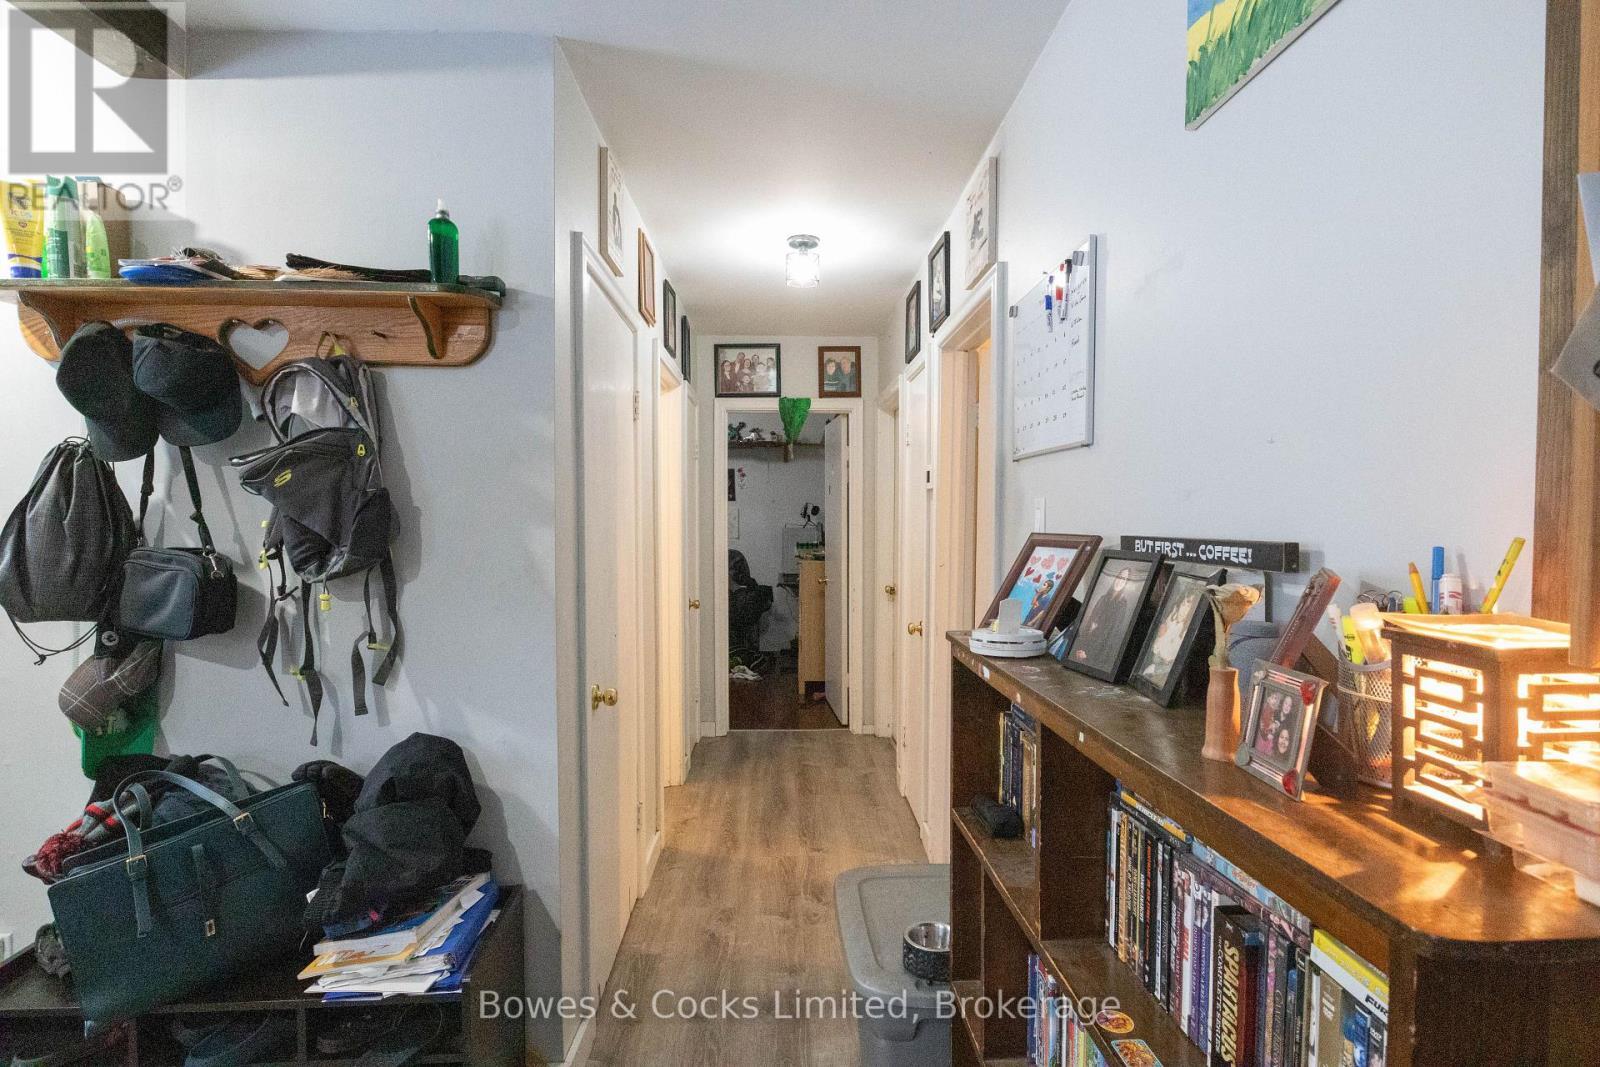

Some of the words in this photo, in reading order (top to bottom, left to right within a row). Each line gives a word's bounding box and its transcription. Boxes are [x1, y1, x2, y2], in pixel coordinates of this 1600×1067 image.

[1134, 539, 1154, 553] BUT
[1154, 540, 1185, 559] FIRST
[1198, 544, 1253, 565] COFFEE!
[1216, 949, 1224, 1011] COMPLETE
[1221, 940, 1240, 1063] SPARTACUS
